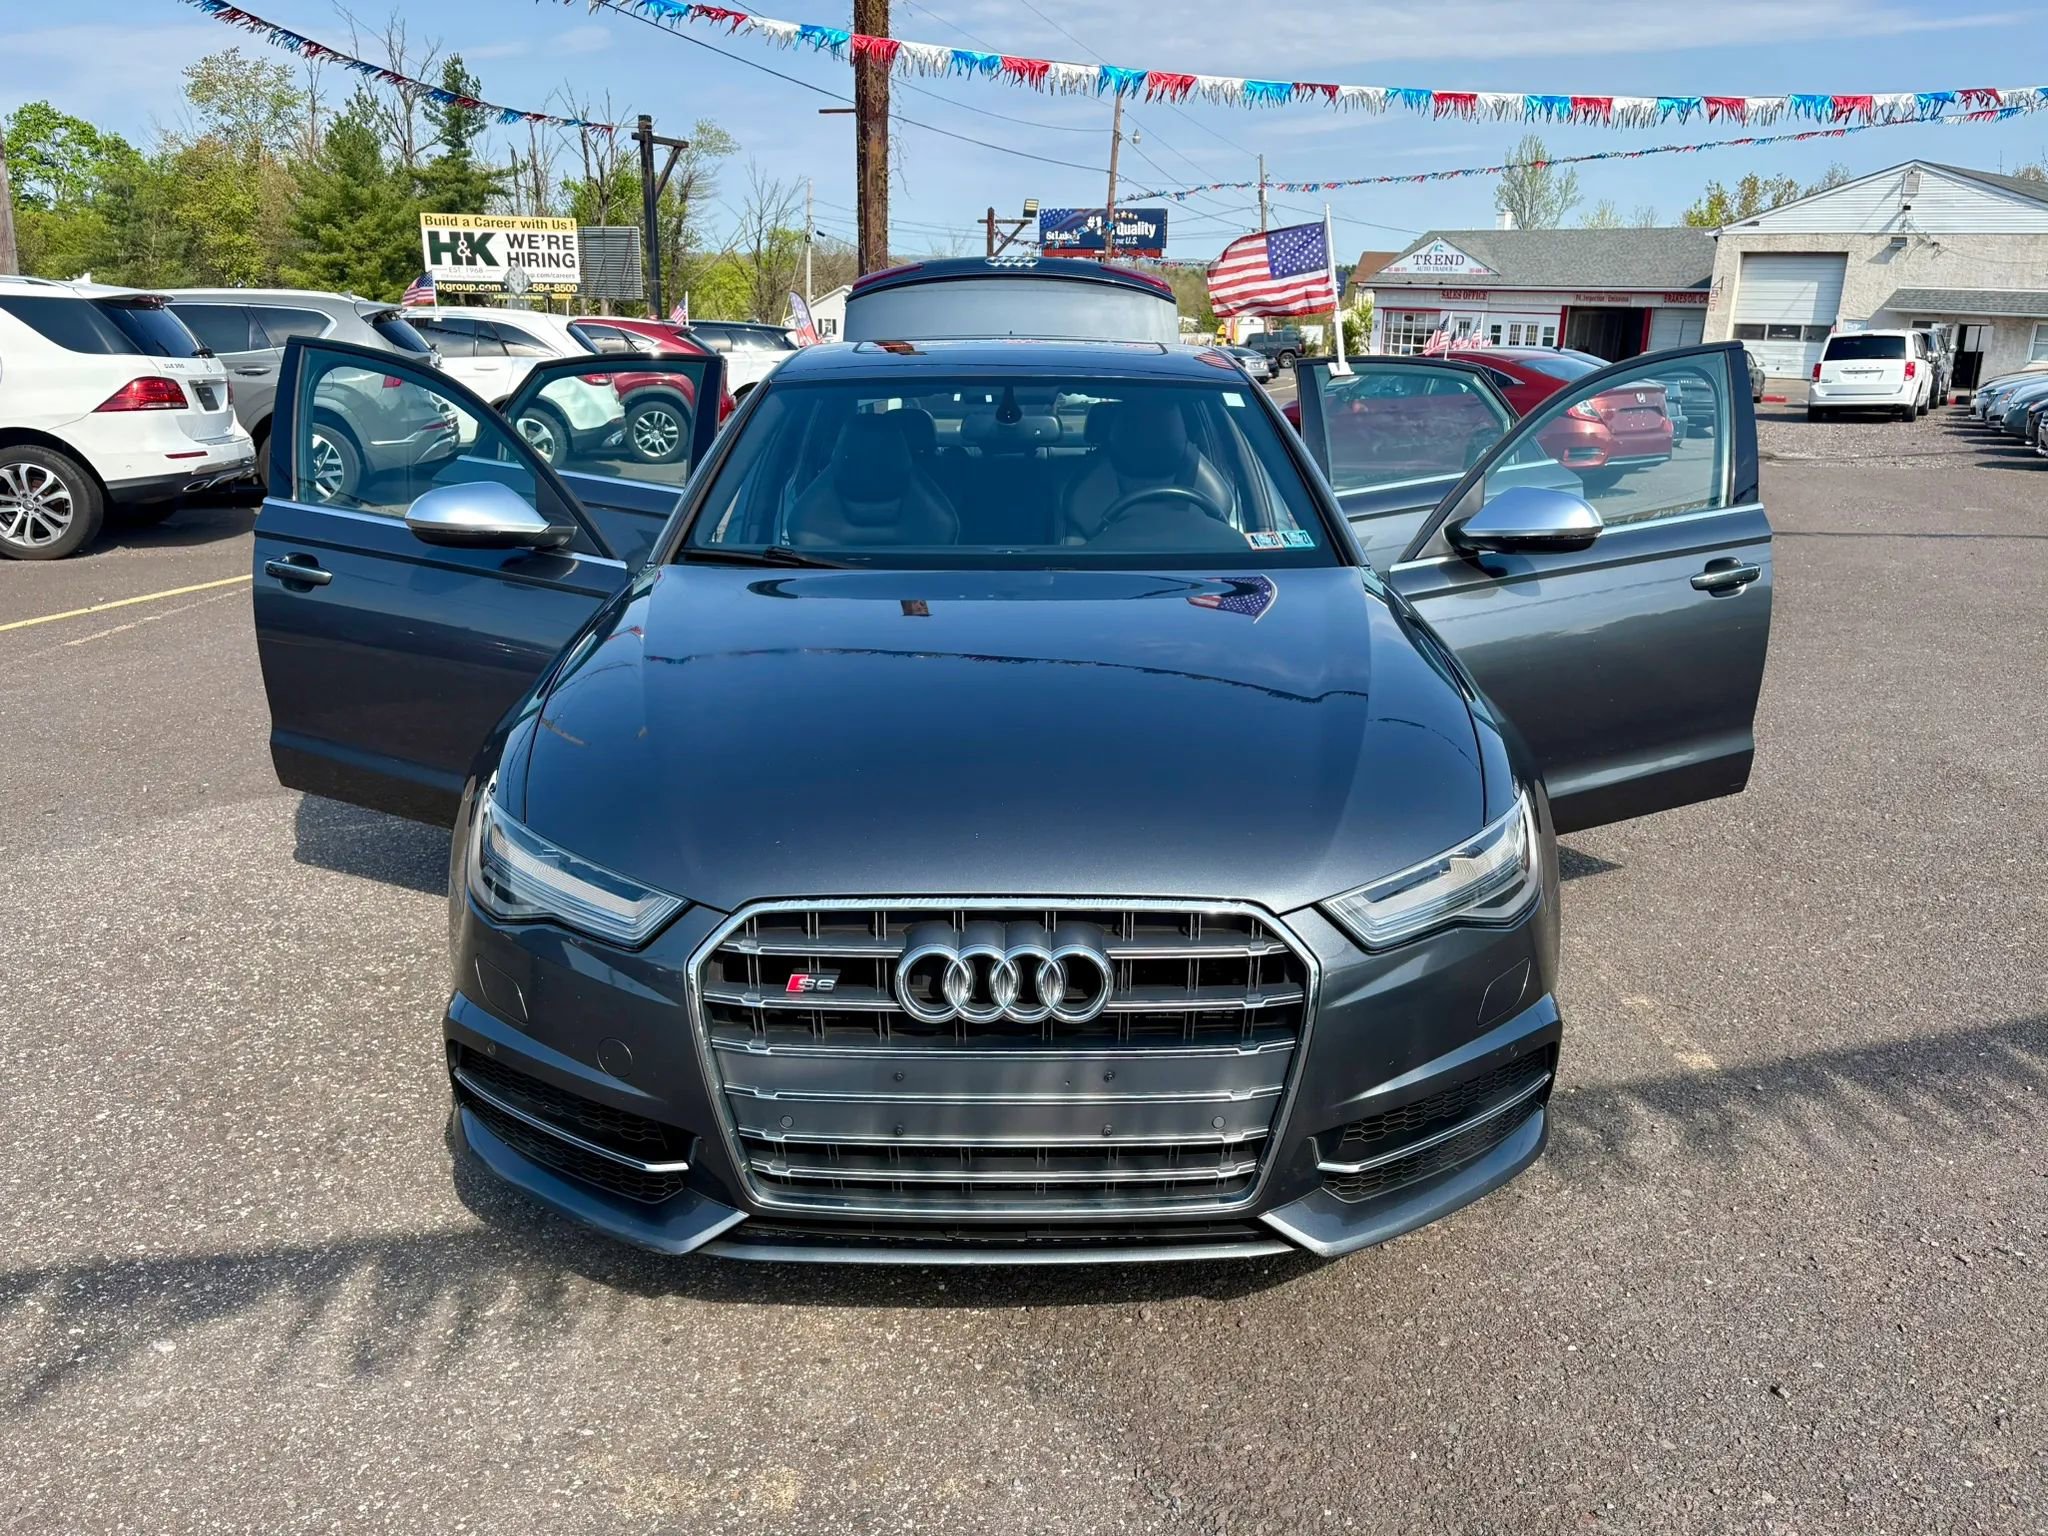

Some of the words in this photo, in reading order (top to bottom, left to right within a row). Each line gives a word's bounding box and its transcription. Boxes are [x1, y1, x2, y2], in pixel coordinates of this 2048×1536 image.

[424, 215, 458, 226] Build
[462, 218, 470, 227] a
[474, 216, 517, 228] Career
[520, 219, 548, 229] with
[1087, 216, 1102, 235] #1
[1116, 221, 1156, 238] Quality
[427, 231, 500, 266] H&K
[506, 233, 575, 250] WE'RE
[507, 251, 576, 268] HIRING
[1413, 254, 1465, 265] TREND
[524, 283, 578, 293] -584-8500
[1441, 289, 1461, 299] SALES
[1462, 290, 1488, 300] OFFICE
[797, 978, 836, 991] S6
